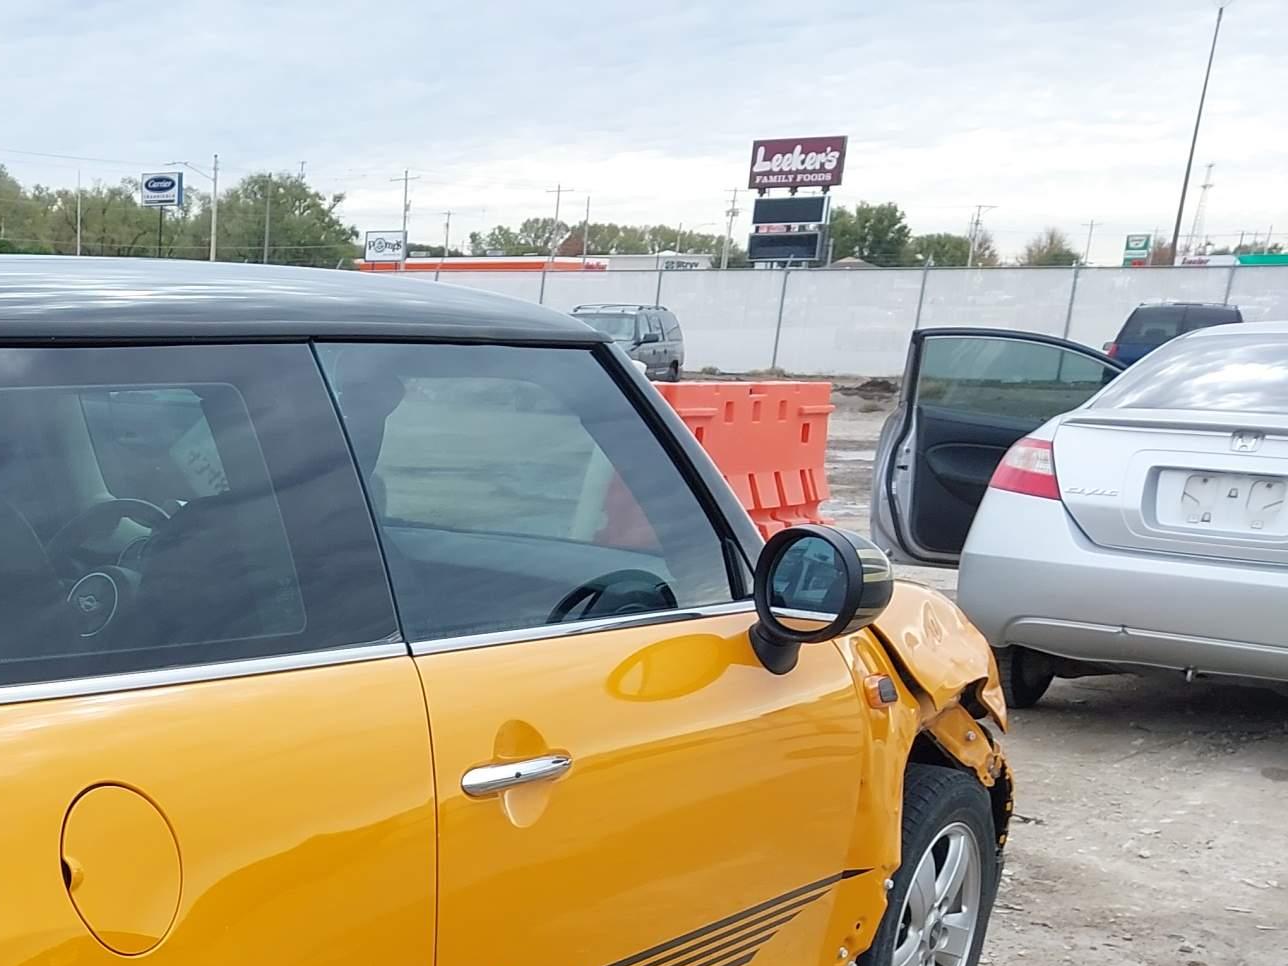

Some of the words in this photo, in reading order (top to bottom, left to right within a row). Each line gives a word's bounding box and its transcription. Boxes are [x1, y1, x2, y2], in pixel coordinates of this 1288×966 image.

[753, 145, 840, 172] Leeker's
[755, 175, 793, 183] FAMILY
[796, 173, 832, 182] FOODS
